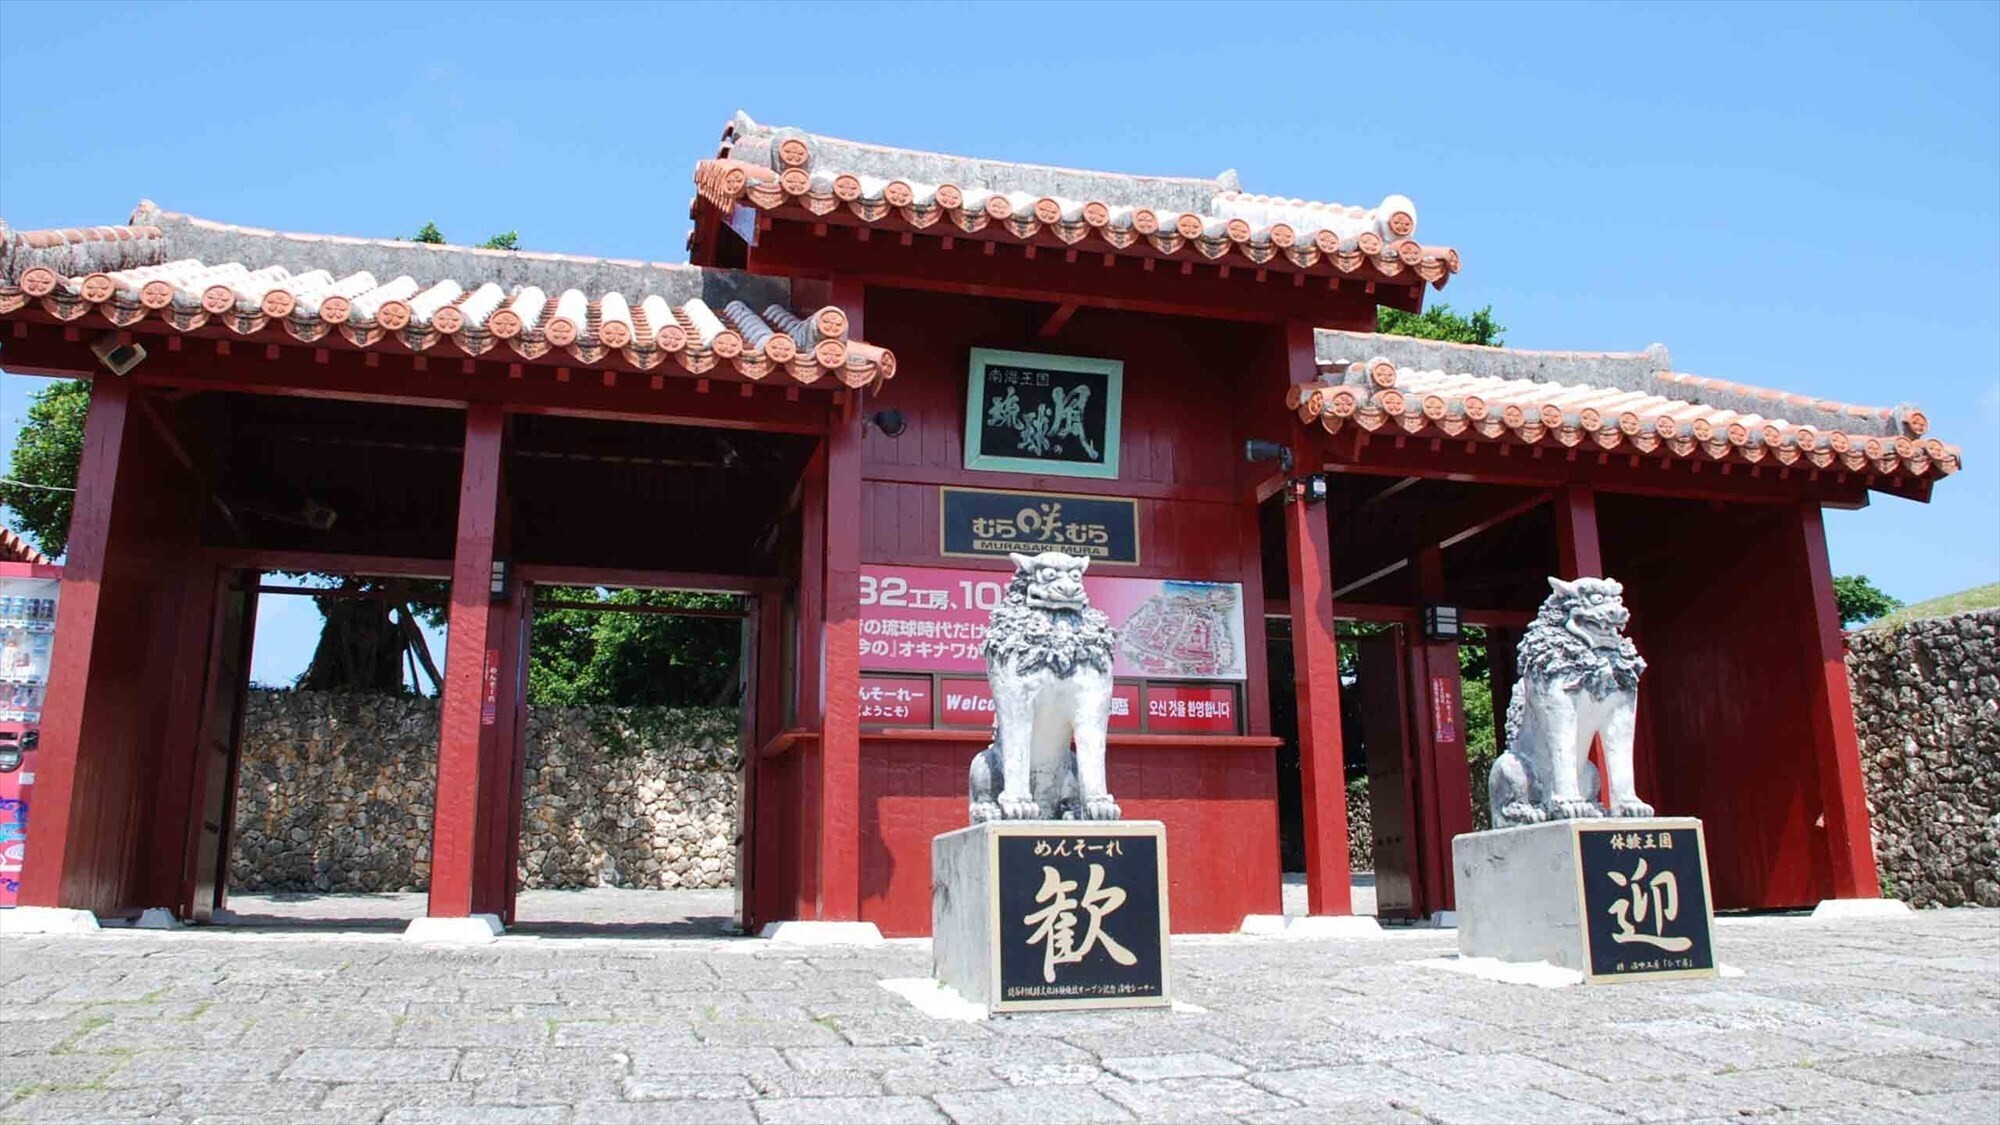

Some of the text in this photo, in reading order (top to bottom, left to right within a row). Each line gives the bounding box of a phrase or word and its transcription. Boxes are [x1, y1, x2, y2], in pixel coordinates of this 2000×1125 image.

[988, 369, 1050, 387] 南海王国
[972, 503, 1109, 544] むら咲むら
[980, 540, 1101, 555] MURASAKI MURA
[859, 618, 988, 639] の琉球時代だけ
[1149, 700, 1230, 719] 오신 것을 환영합니다
[1033, 838, 1124, 858] めんそーれ
[1610, 832, 1673, 850] 体験王国
[1607, 857, 1693, 952] 迎
[1023, 863, 1138, 984] 歓
